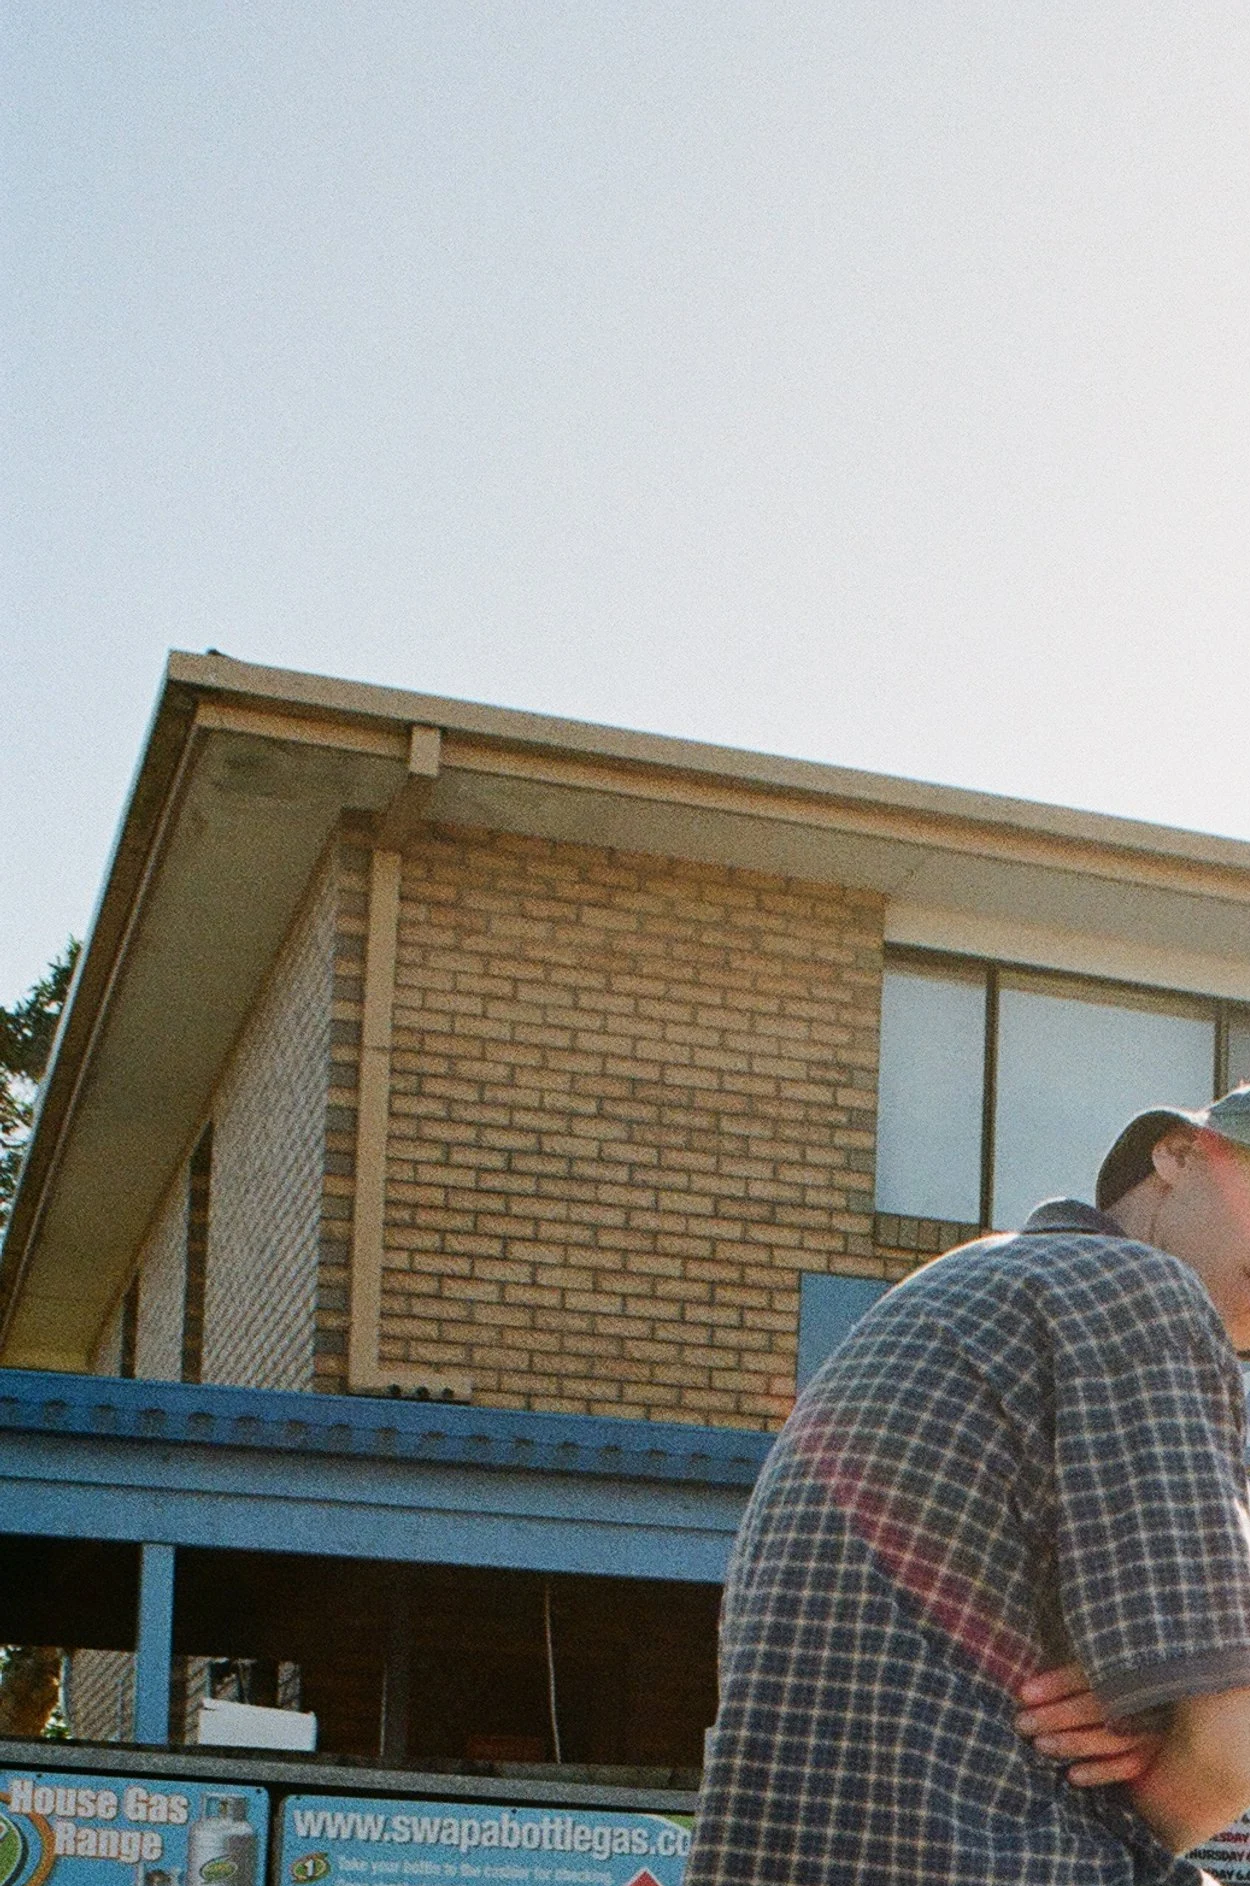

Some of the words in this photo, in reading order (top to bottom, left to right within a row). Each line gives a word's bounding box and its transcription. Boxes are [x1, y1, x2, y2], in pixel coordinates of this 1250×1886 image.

[9, 1779, 118, 1820] House
[124, 1786, 189, 1824] Gas
[54, 1820, 162, 1863] Range
[304, 1859, 314, 1876] 1
